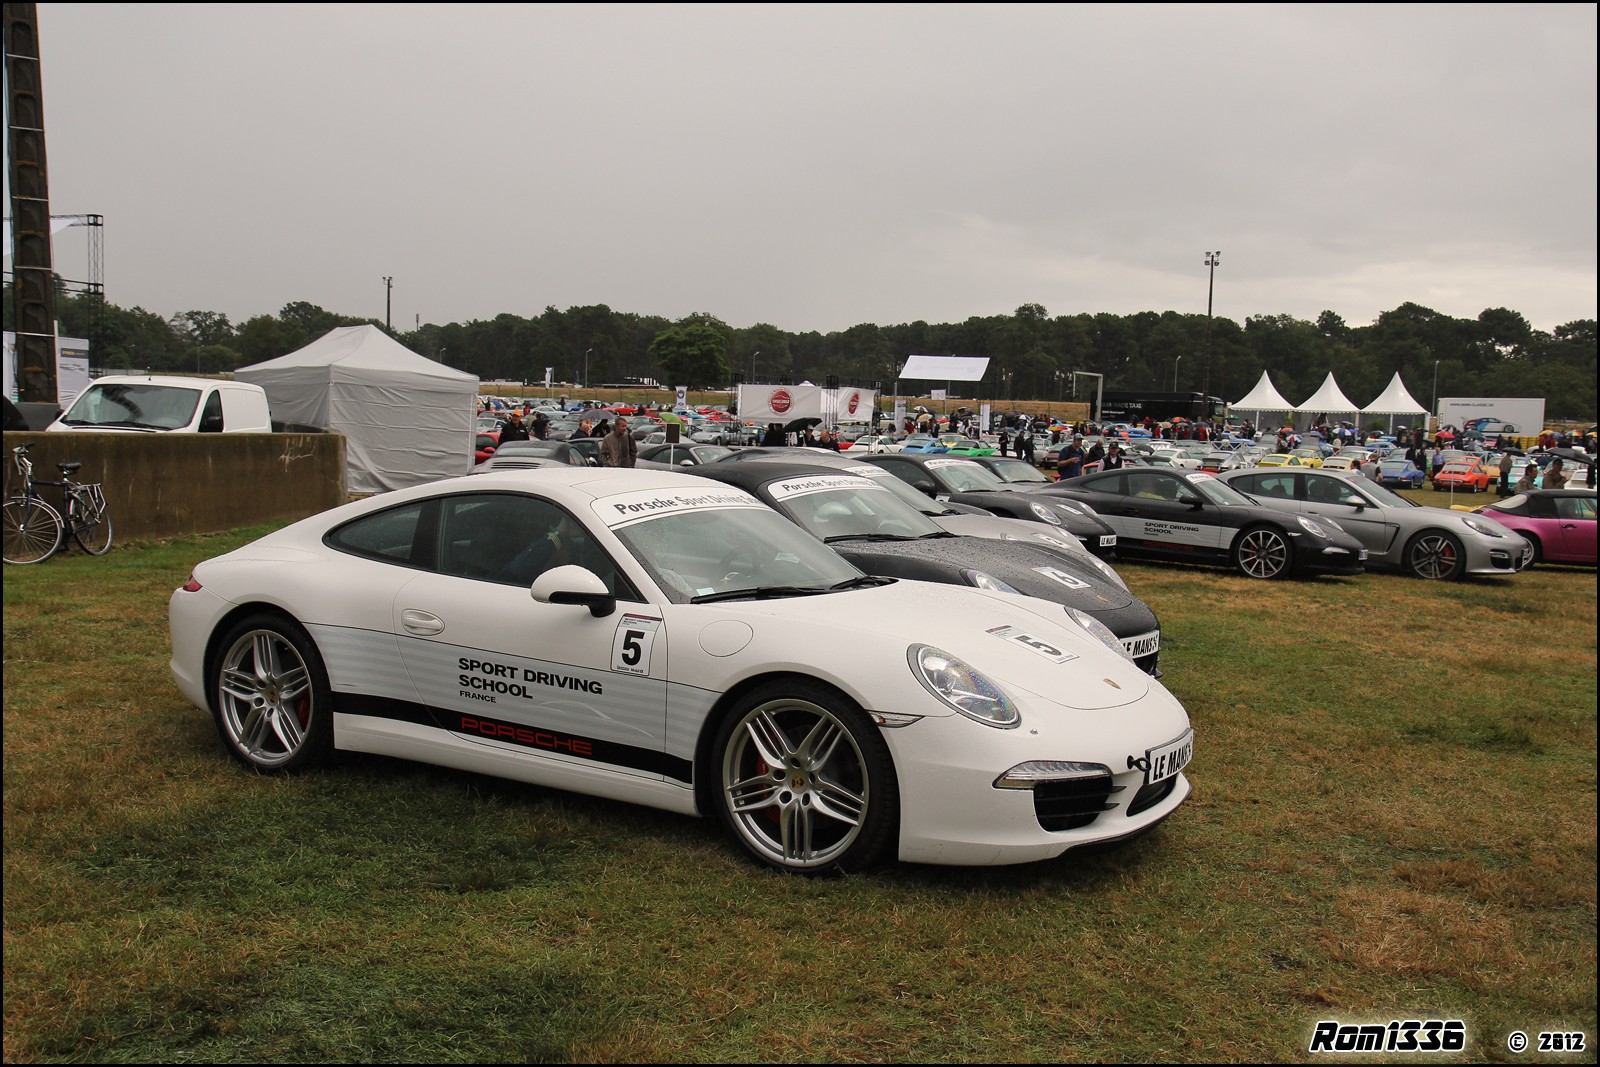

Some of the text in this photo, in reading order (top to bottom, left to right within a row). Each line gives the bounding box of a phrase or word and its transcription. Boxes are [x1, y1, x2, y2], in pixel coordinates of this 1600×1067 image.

[781, 480, 824, 492] Porsche
[613, 497, 678, 515] Porsche
[674, 494, 707, 507] Sport
[1144, 521, 1199, 532] SPORT DRIVING
[1144, 527, 1173, 535] SCHOOL
[1050, 571, 1080, 585] 6
[622, 629, 646, 666] 5
[1014, 635, 1063, 657] 5
[458, 656, 603, 695] SPORT DRIVING
[458, 674, 534, 700] SCHOOL
[459, 690, 497, 704] FRANCE
[461, 717, 593, 756] PORSCHE
[1153, 755, 1166, 781] LE
